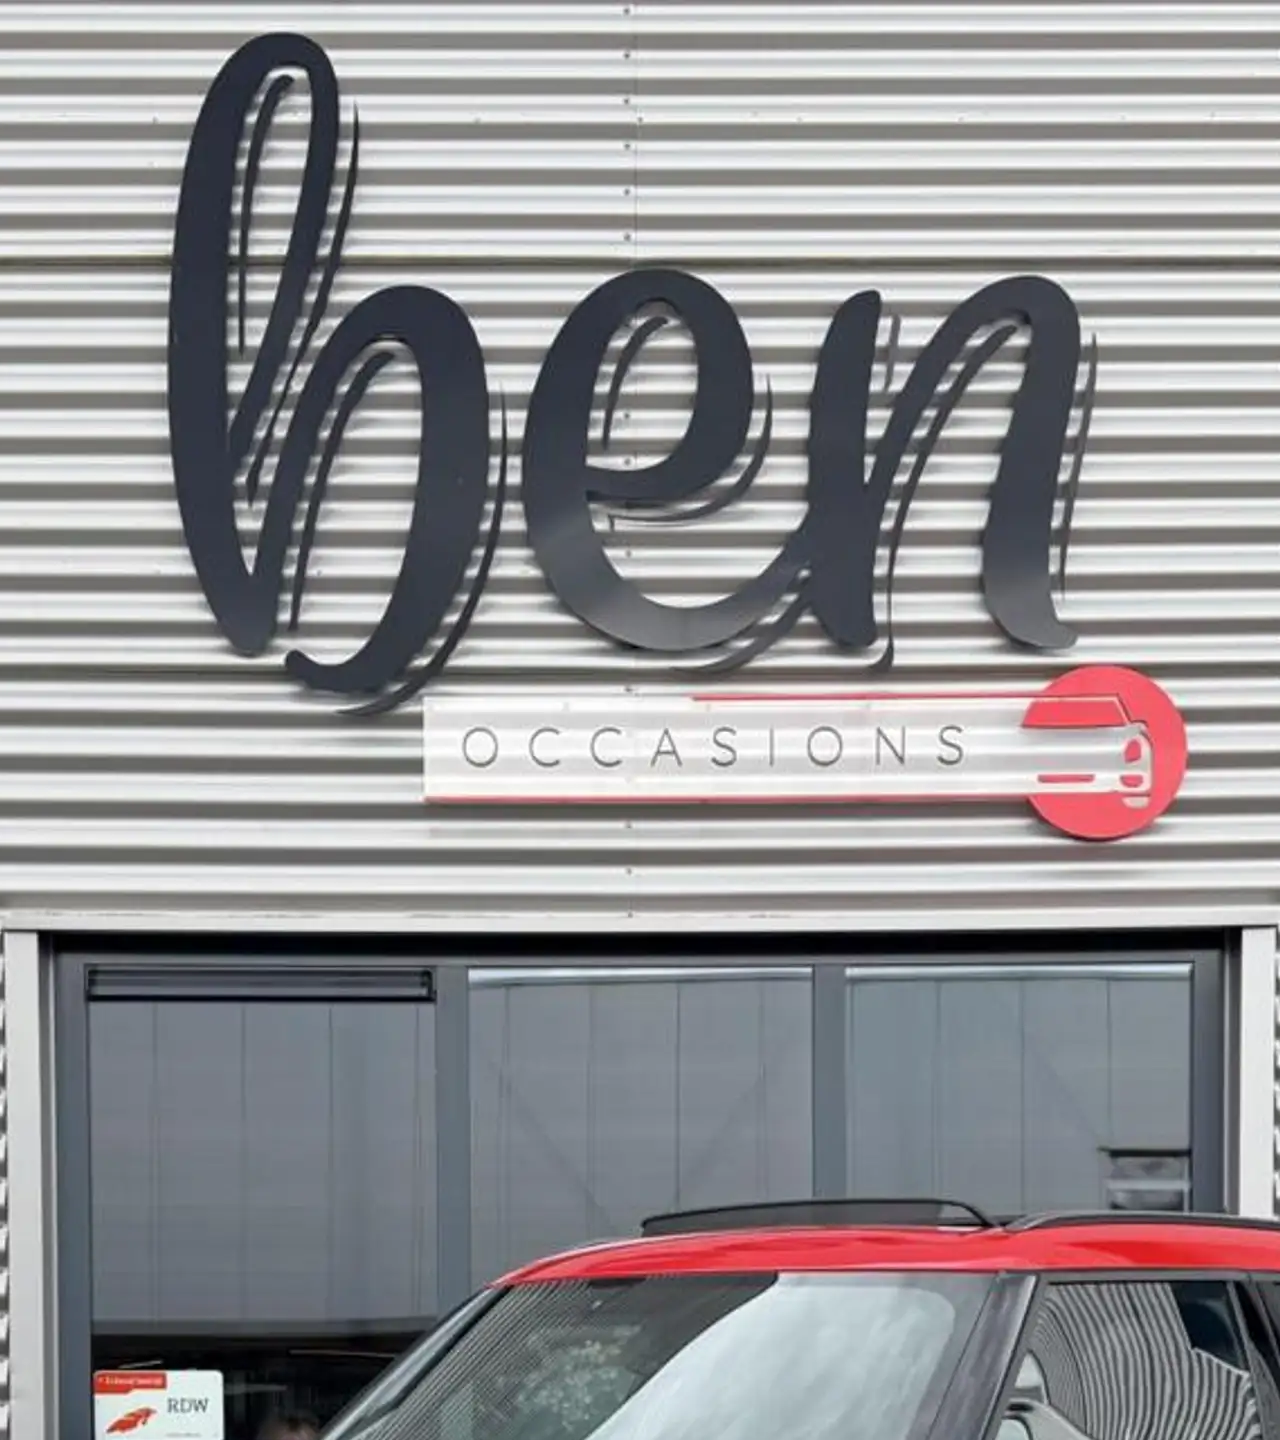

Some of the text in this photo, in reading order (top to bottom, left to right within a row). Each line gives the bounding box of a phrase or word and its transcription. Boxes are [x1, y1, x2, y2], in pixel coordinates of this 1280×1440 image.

[167, 32, 1096, 712] ben
[460, 724, 965, 768] OCCASIONS
[166, 1397, 209, 1414] RDW
